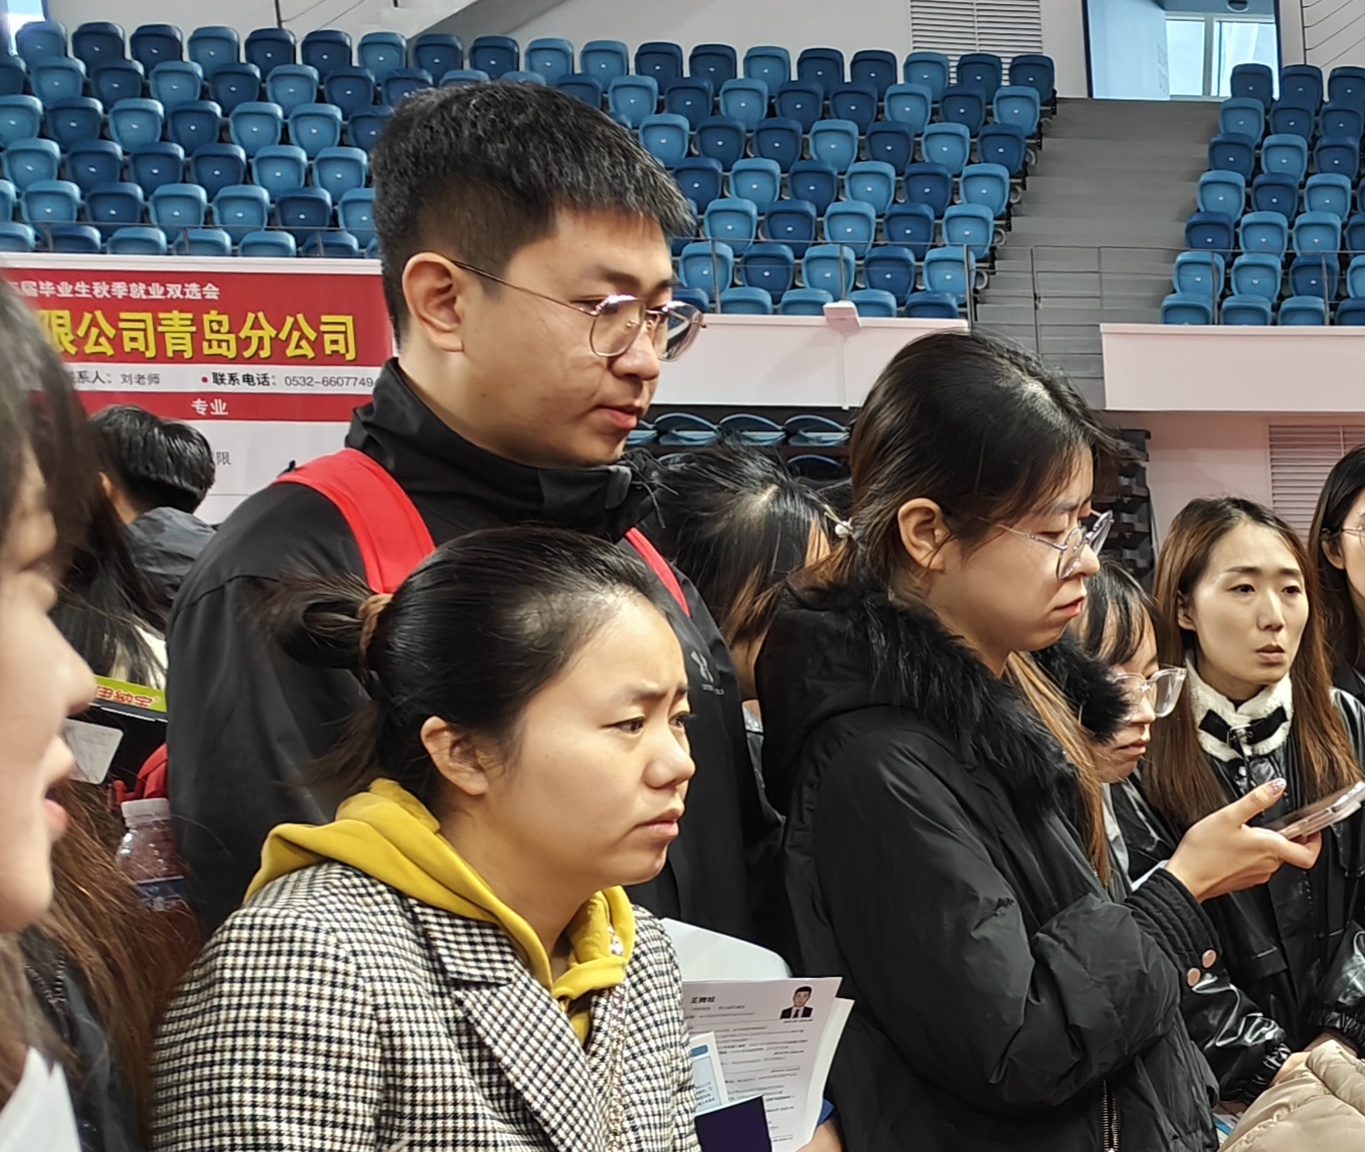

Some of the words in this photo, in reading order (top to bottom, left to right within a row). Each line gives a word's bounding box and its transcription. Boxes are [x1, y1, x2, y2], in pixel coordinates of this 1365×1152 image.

[120, 373, 160, 386] 刘老师
[191, 398, 229, 416] 专业
